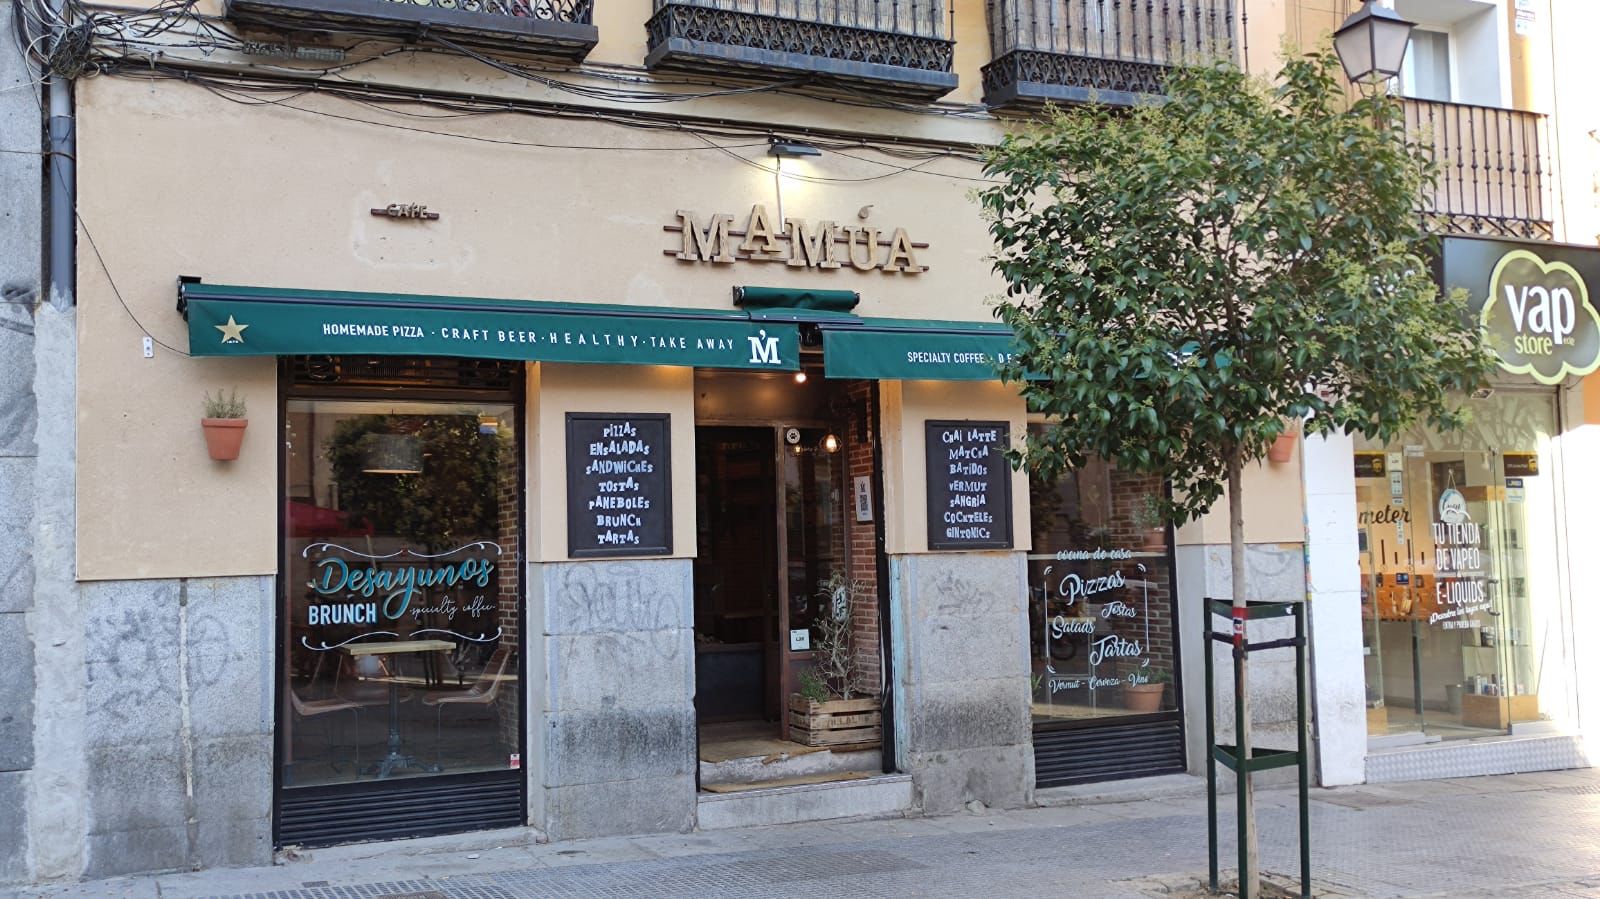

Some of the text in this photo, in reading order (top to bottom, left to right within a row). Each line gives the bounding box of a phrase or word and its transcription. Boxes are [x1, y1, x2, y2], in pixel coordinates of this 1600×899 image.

[676, 203, 924, 273] MAMÚA
[1504, 284, 1576, 345] vap
[322, 323, 735, 351] HOMEMADE PIZZA CRAFT BEER HEALTHY TAKE AWAY
[1514, 334, 1553, 356] store
[907, 351, 951, 364] SPECIALTY
[953, 352, 985, 365] COFFEE
[1432, 523, 1481, 545] TU TIENDA
[1093, 546, 1107, 560] de
[1109, 548, 1132, 560] casa
[1436, 548, 1480, 570] DE VAPEO
[314, 557, 495, 620] Desayunos
[1059, 570, 1126, 606] Pizzas
[1436, 581, 1484, 606] E-LIQUIDS
[308, 603, 377, 625] BRUNCH
[1101, 600, 1137, 619] Tostas
[1052, 615, 1096, 639] Salads
[1089, 634, 1144, 666] Tartas
[1048, 679, 1081, 694] Vermut
[1088, 675, 1120, 690] Cerveza
